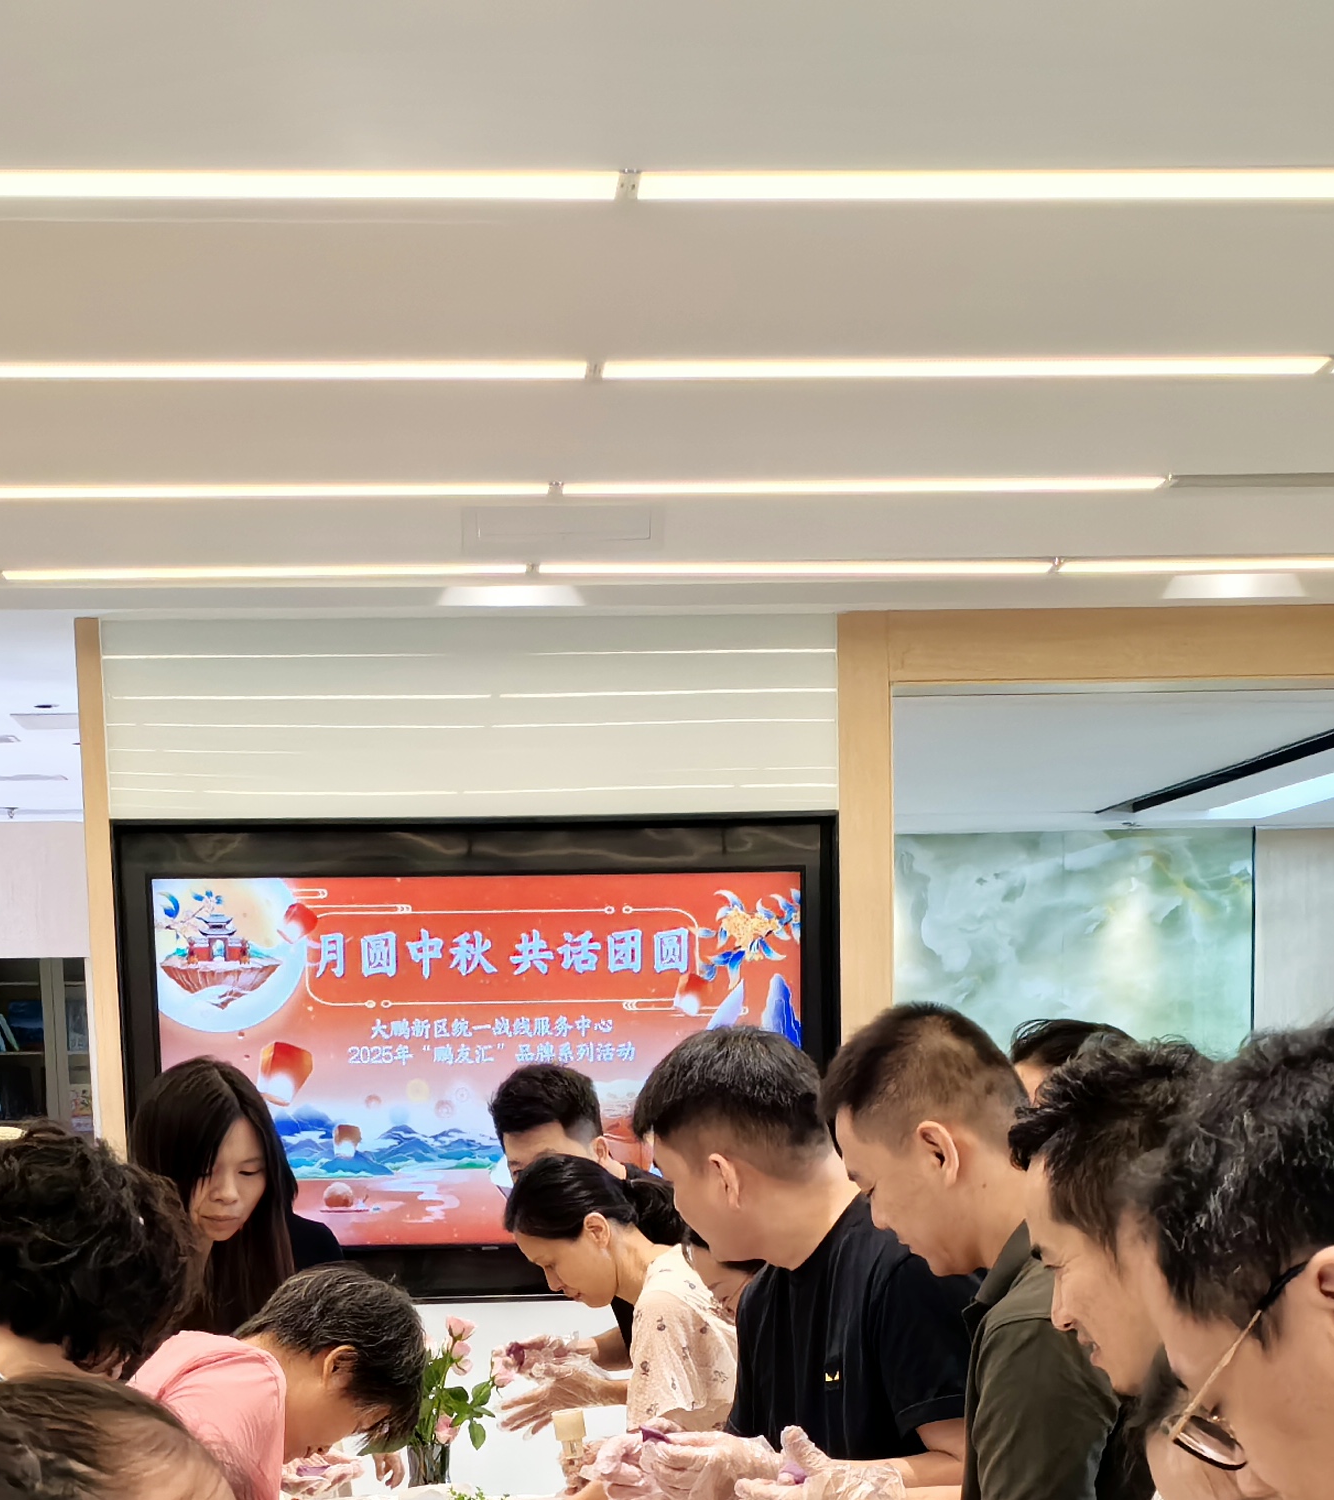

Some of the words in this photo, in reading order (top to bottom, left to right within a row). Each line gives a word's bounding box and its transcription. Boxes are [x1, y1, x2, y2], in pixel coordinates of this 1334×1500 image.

[315, 928, 499, 980] 月圆中秋
[509, 927, 691, 979] 共话团圆
[370, 1015, 614, 1041] 大鹏新区统一战线服务中心
